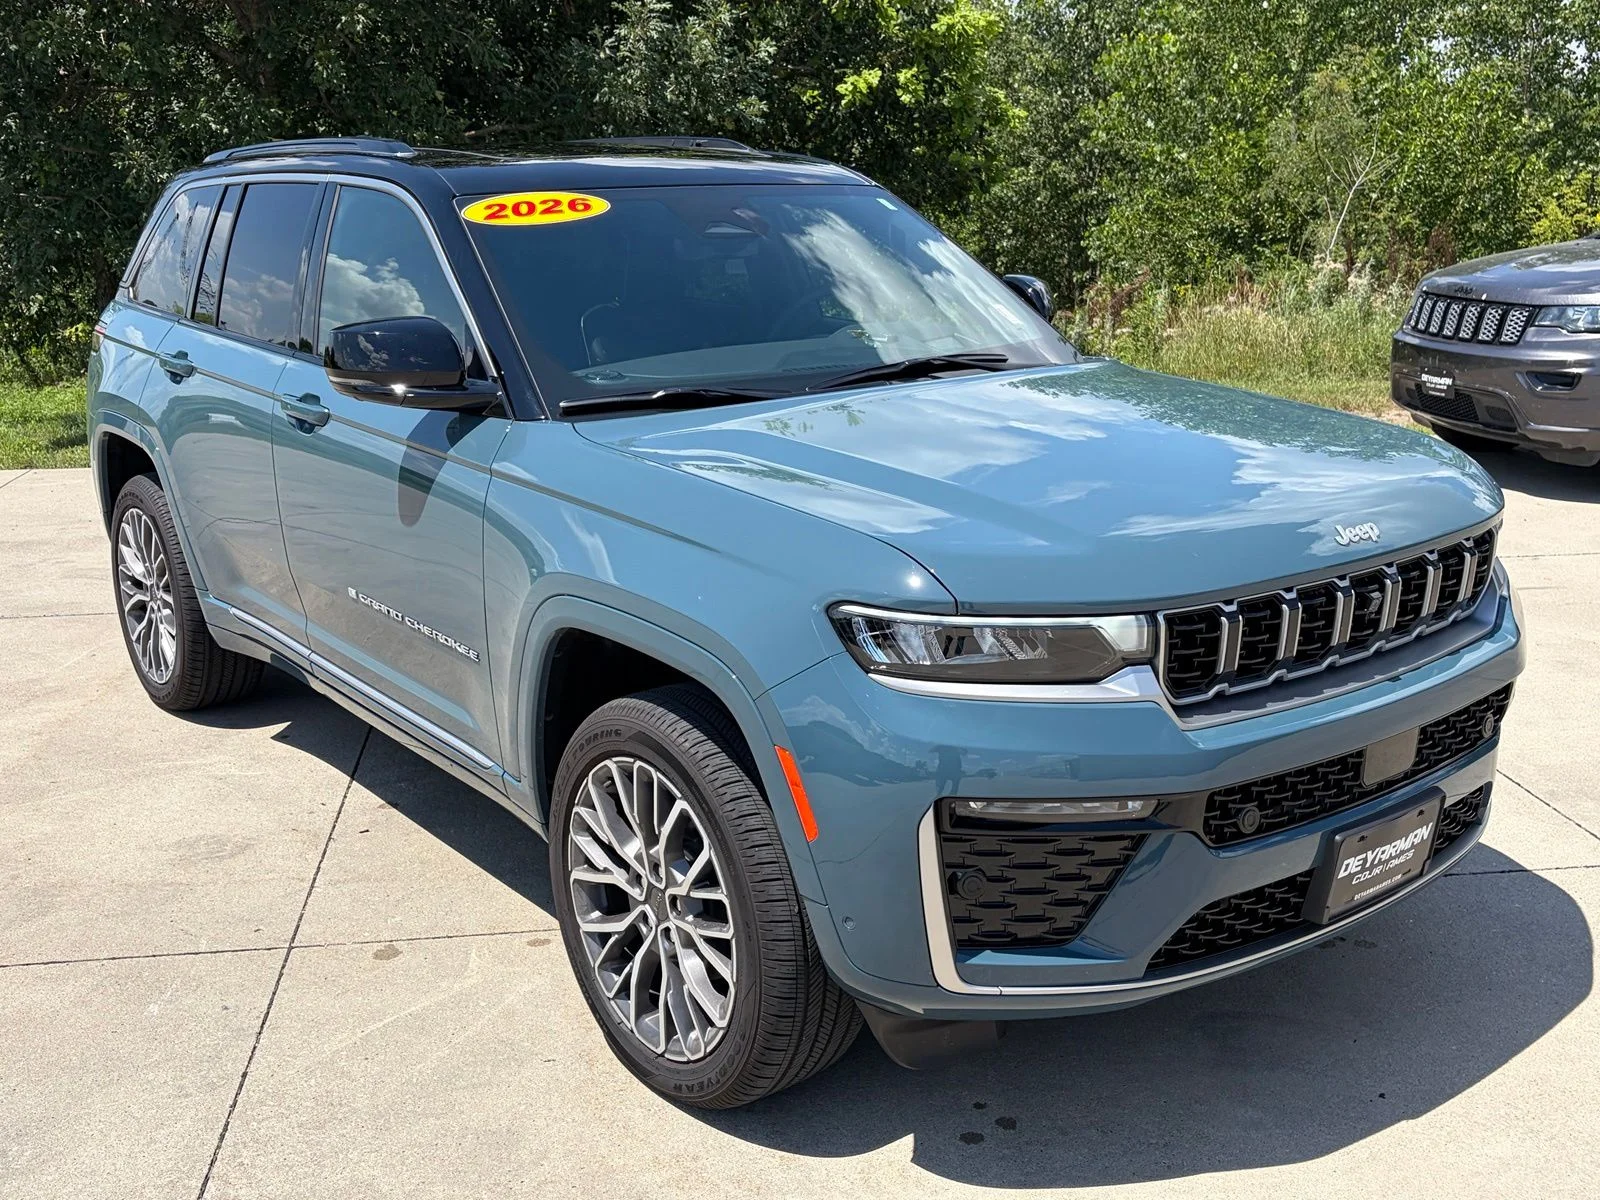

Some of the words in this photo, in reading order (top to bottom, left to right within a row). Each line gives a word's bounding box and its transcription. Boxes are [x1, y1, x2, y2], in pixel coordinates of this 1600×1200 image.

[483, 198, 593, 221] 2026
[1334, 522, 1380, 546] Jeep
[358, 593, 402, 621] GRAND
[405, 616, 480, 662] CHEROKEE
[1337, 822, 1433, 879] DEYARMAN
